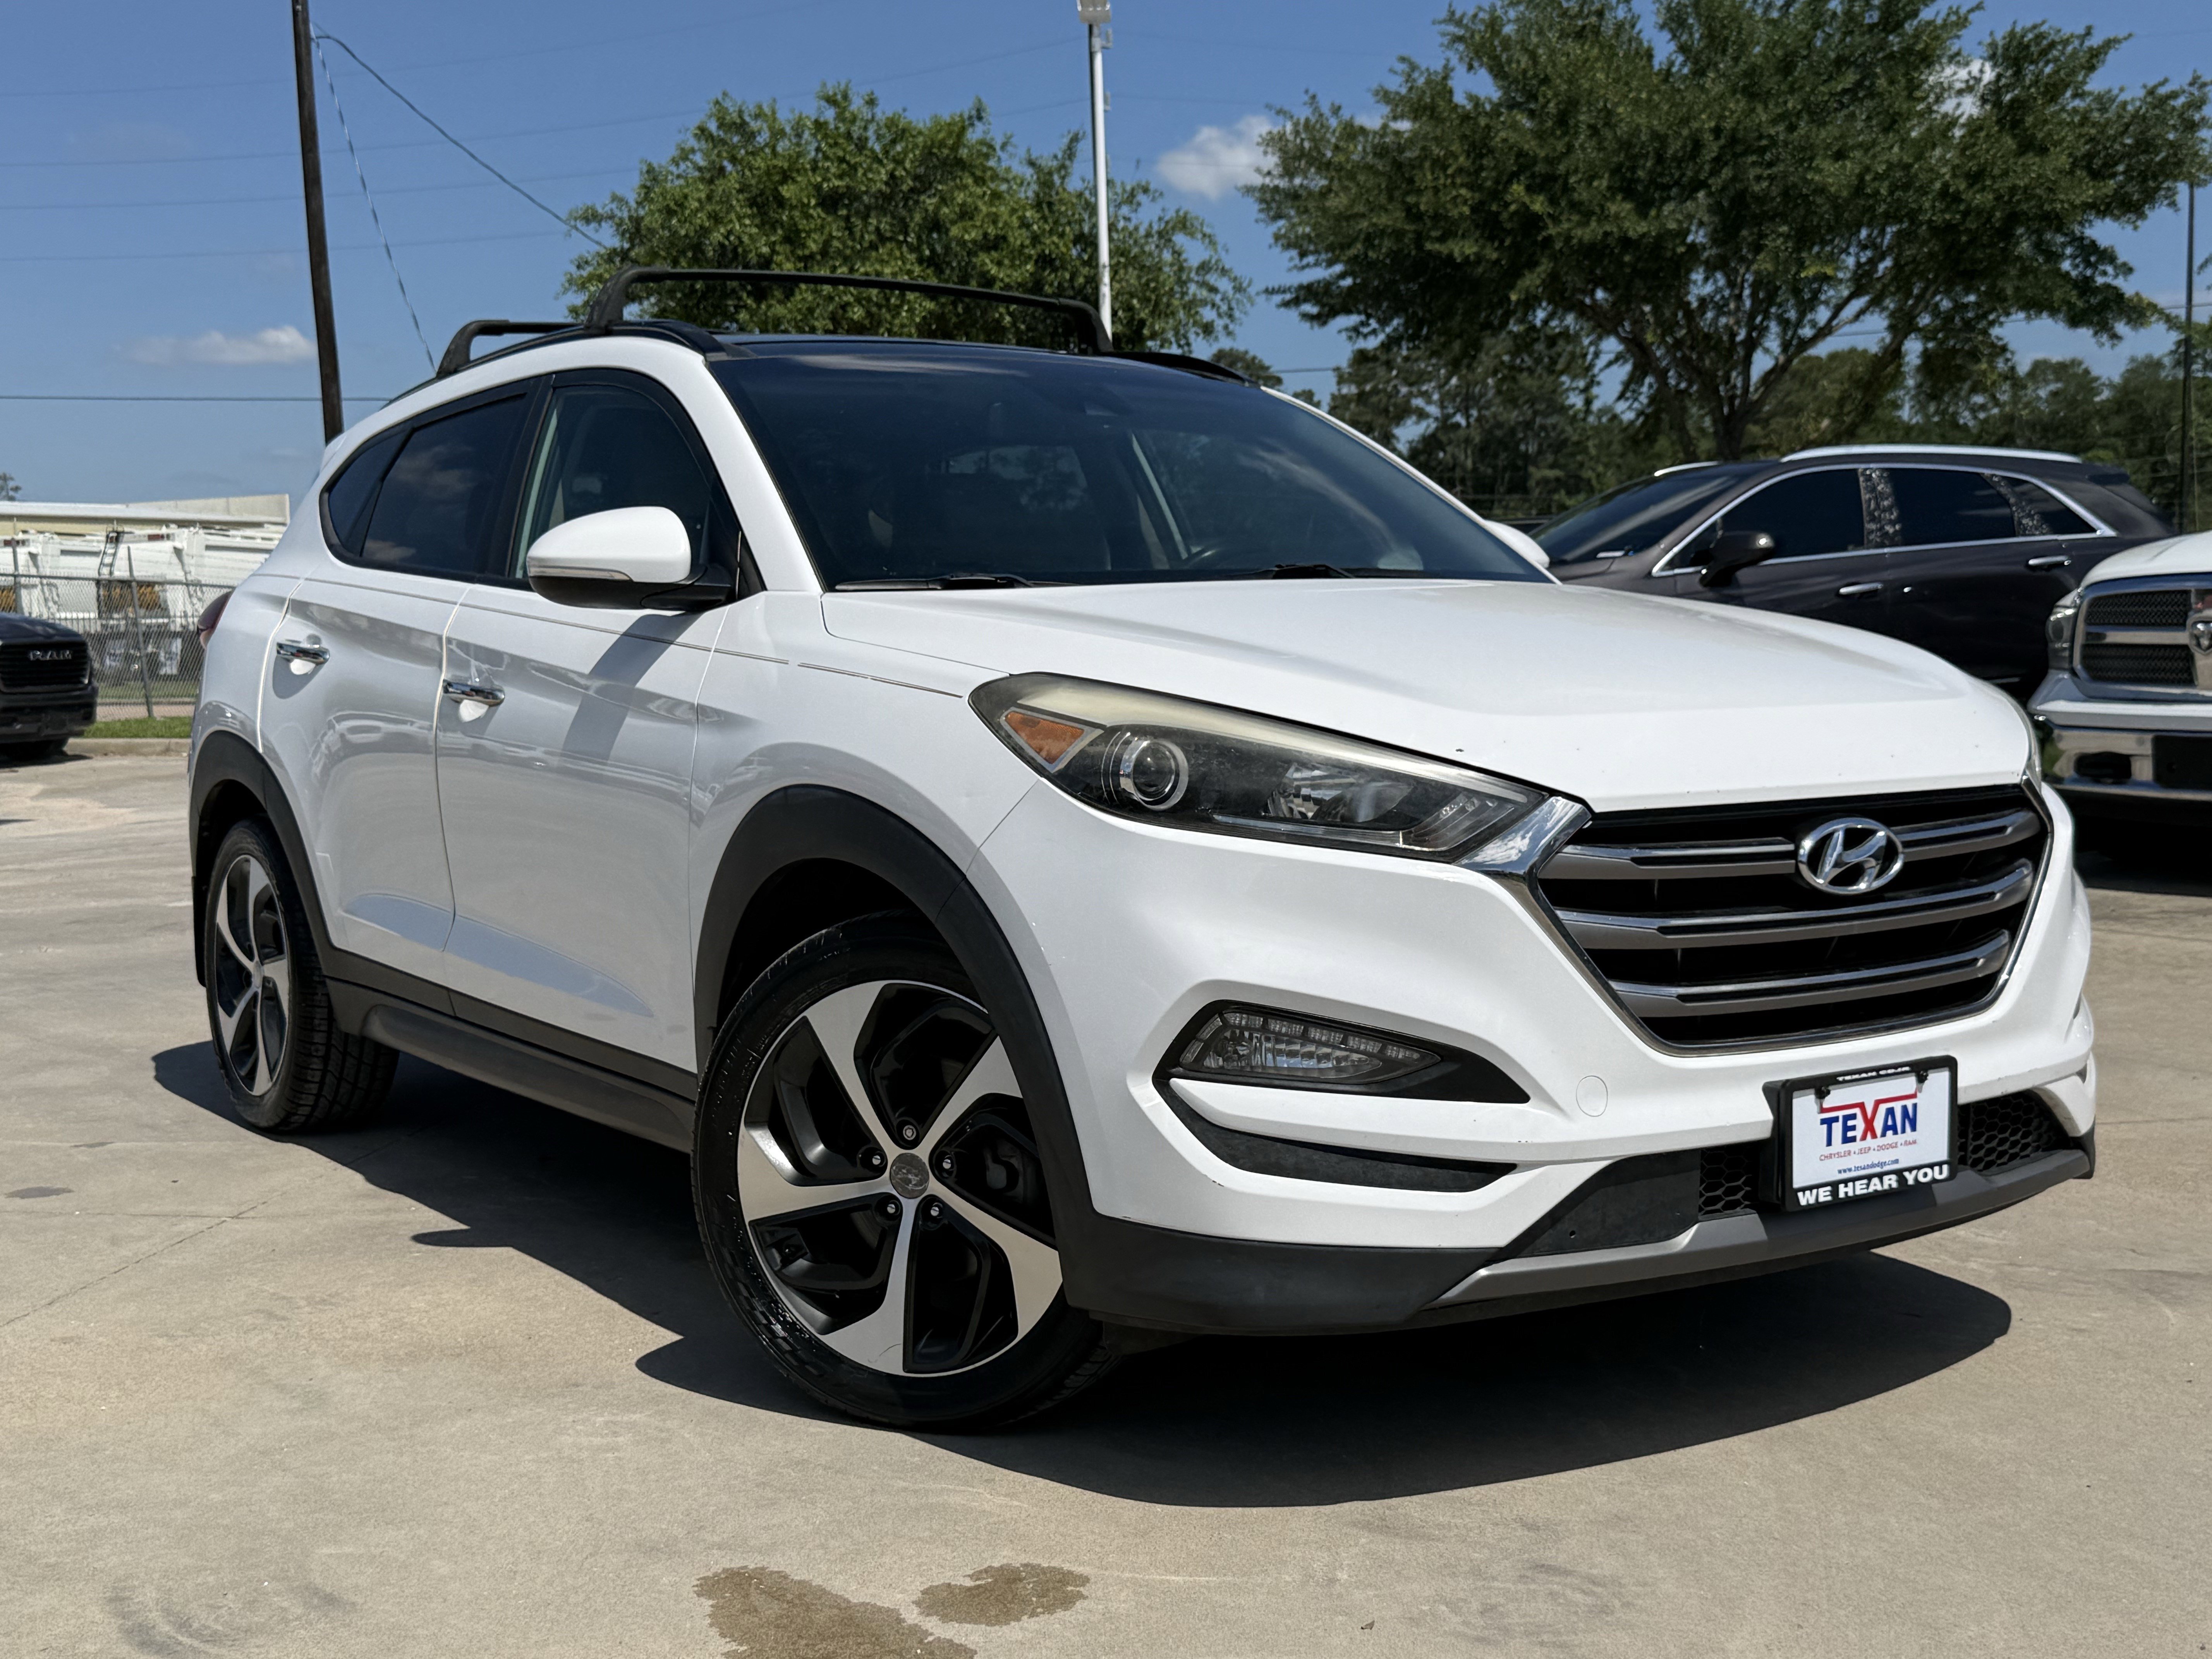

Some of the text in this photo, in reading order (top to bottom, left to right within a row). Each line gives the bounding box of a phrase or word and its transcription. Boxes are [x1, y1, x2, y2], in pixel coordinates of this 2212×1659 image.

[1836, 1071, 1877, 1081] TEXAN
[1820, 1099, 1918, 1147] TEXAN
[1819, 1139, 1917, 1161] CHRYSLER JEEP DODGE RAM
[1797, 1164, 1949, 1206] WE HEAR YOU
